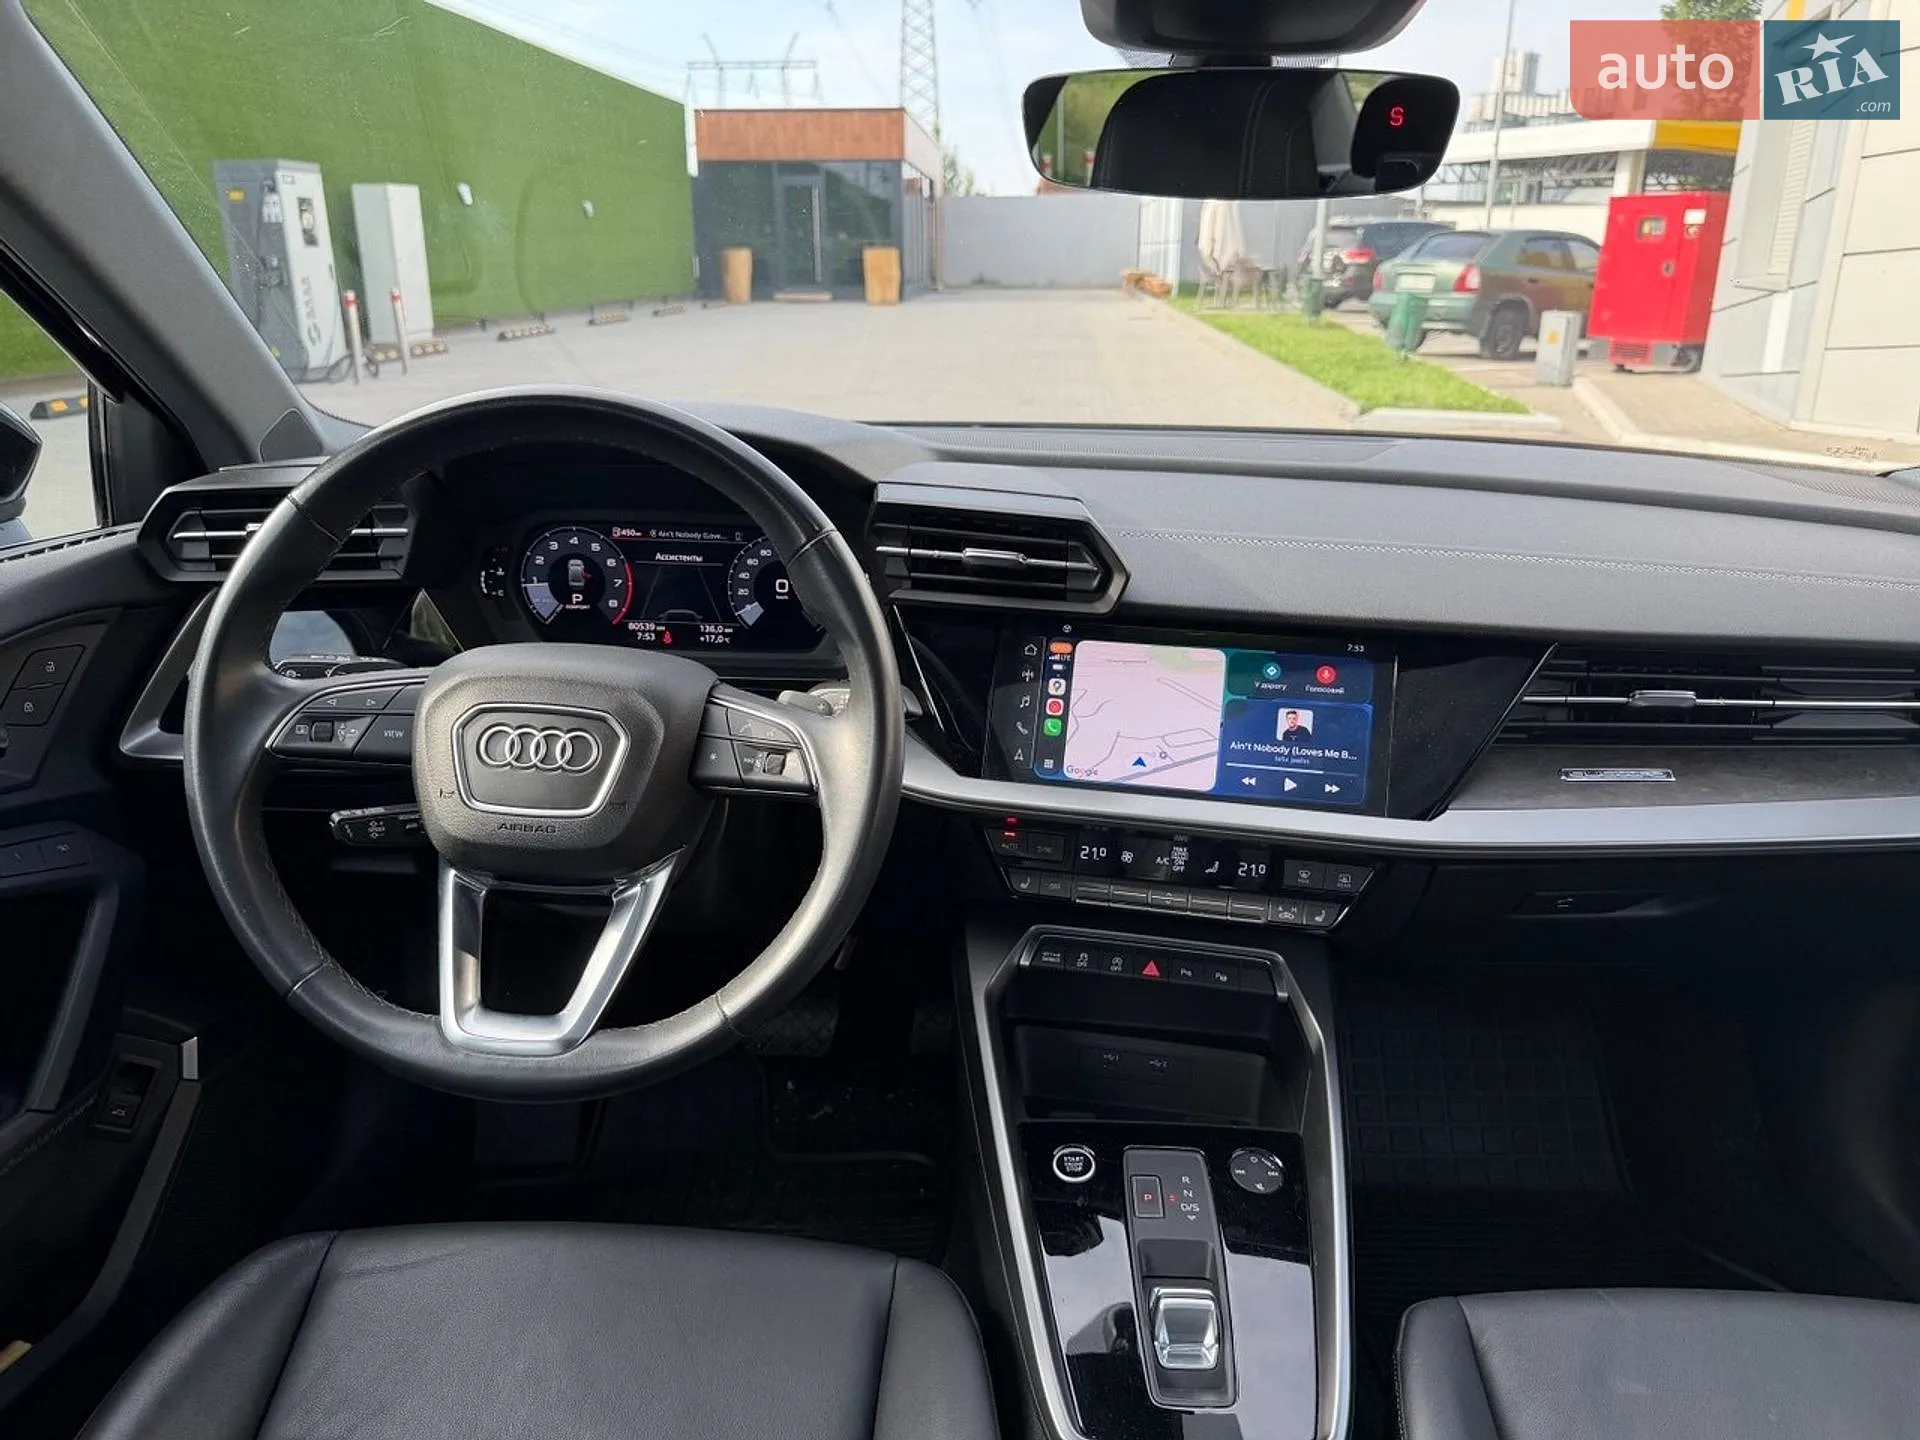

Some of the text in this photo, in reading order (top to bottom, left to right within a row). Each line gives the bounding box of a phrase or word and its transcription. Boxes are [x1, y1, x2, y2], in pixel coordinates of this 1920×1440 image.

[1390, 106, 1404, 126] S
[620, 528, 635, 537] 450
[569, 536, 579, 545] 4
[548, 541, 559, 551] 3
[591, 543, 601, 552] 5
[655, 552, 703, 562] Ассистенты
[760, 548, 772, 557] 80
[535, 555, 545, 565] 2
[606, 558, 617, 567] 6
[746, 558, 759, 566] 60
[532, 576, 538, 585] 1
[613, 579, 623, 588] 7
[775, 578, 789, 594] 0
[737, 587, 750, 596] 20
[571, 593, 584, 605] P
[608, 599, 618, 608] 8
[627, 622, 656, 631] 80539
[637, 631, 656, 641] 7:53
[1347, 643, 1365, 652] 7:53
[383, 729, 405, 739] VIEW
[1230, 741, 1252, 750] Ain't
[1253, 743, 1290, 755] Nobody
[1291, 746, 1323, 758] (Loves
[1324, 749, 1339, 758] Me
[1066, 764, 1099, 778] Google
[498, 822, 557, 834] AIRBAG
[1181, 1175, 1191, 1184] R
[1144, 1193, 1152, 1201] P
[1183, 1189, 1193, 1198] N
[1180, 1202, 1200, 1212] D/S
